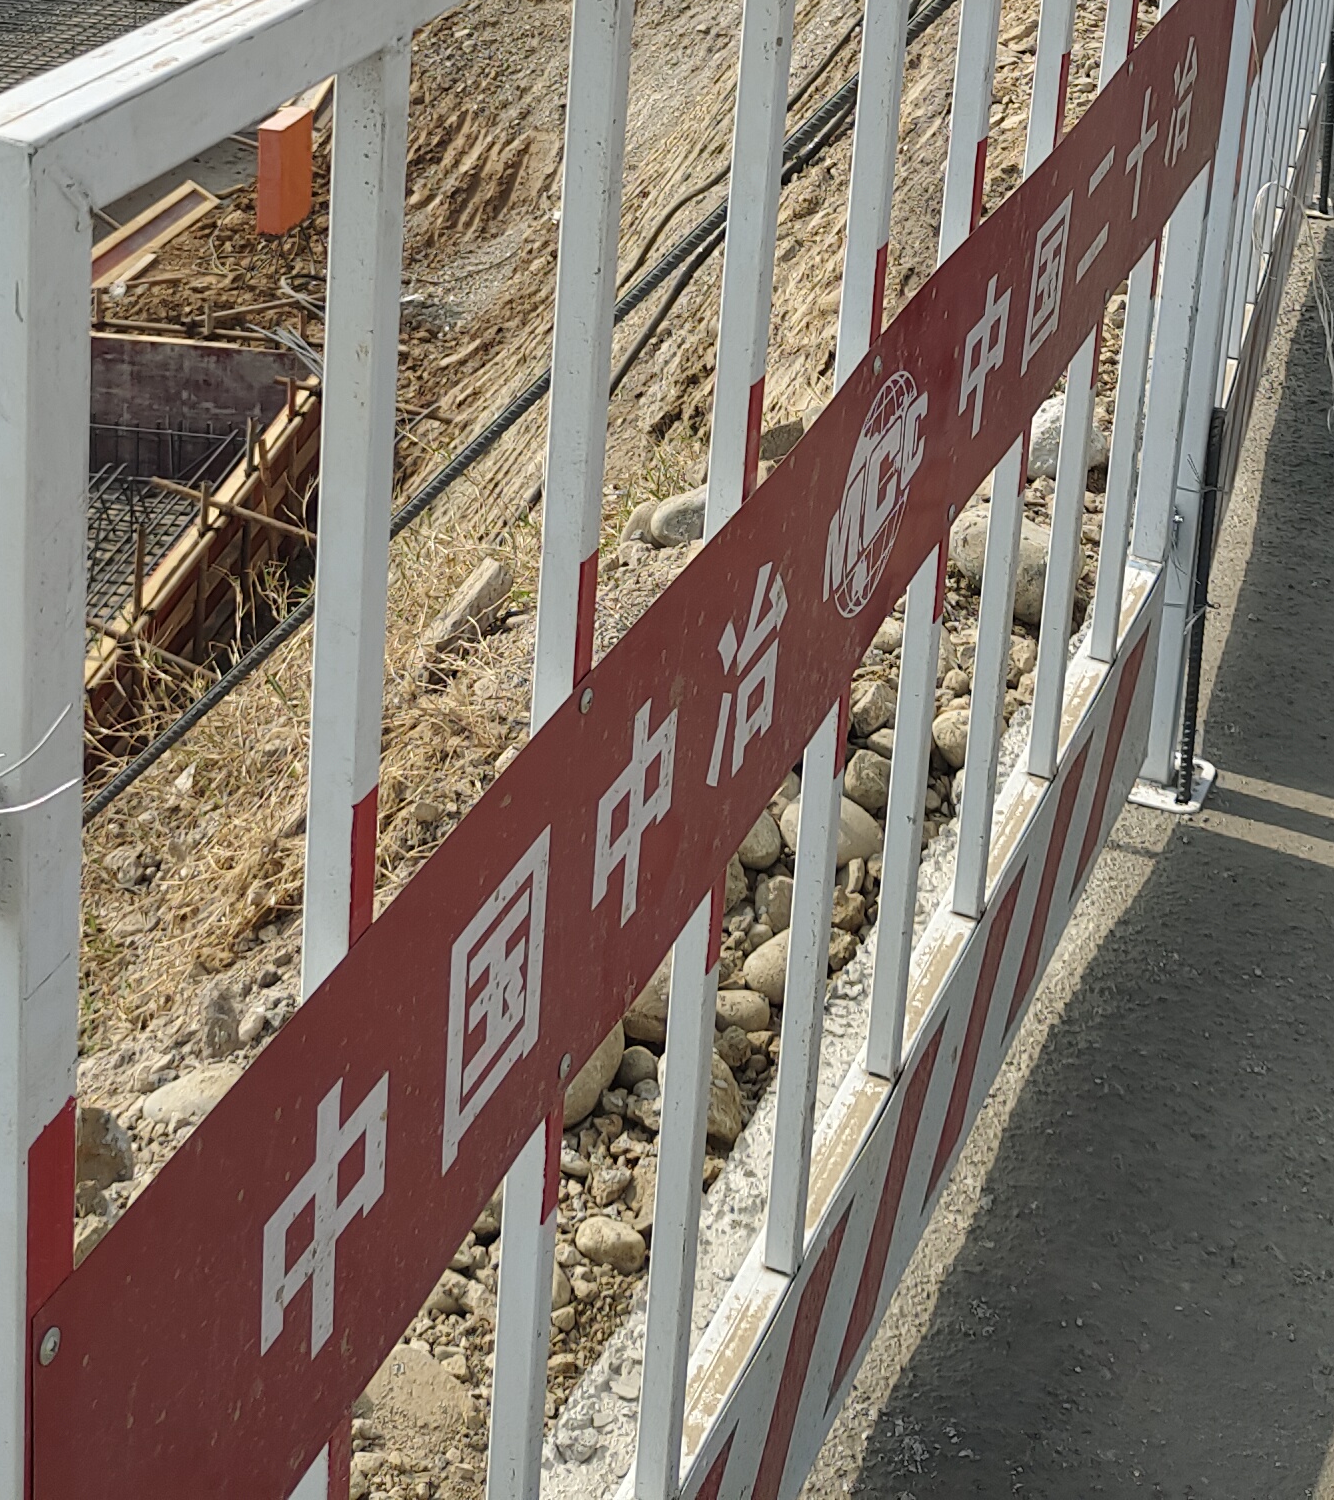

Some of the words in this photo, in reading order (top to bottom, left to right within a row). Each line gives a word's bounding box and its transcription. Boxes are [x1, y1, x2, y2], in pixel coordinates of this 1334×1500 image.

[261, 562, 788, 1360] 中国中冶
[822, 390, 929, 604] MCC
[958, 35, 1198, 440] 中国二十冶
